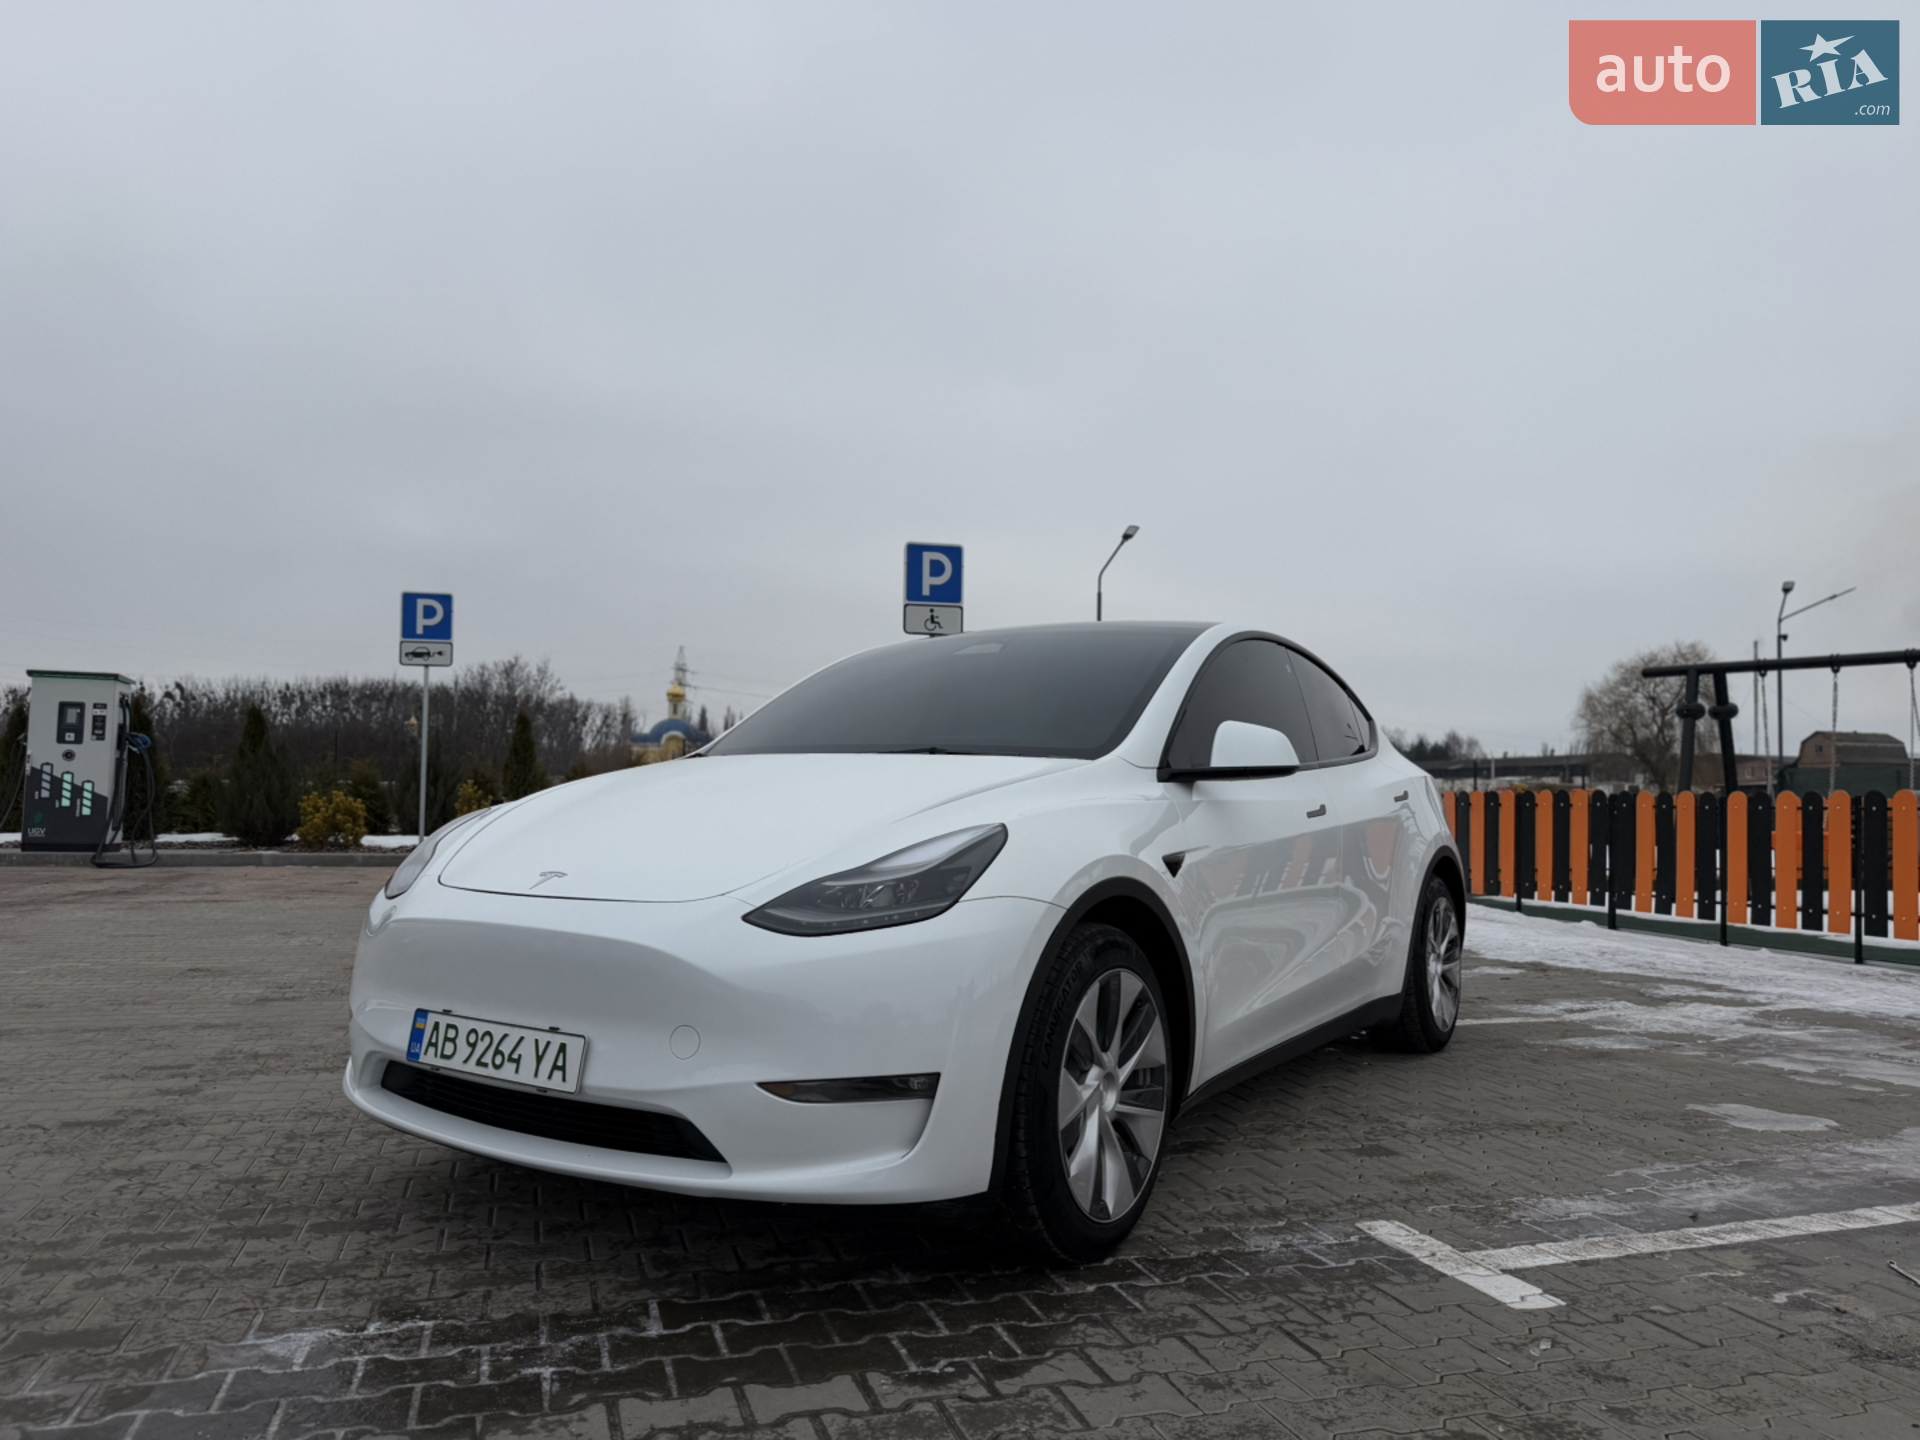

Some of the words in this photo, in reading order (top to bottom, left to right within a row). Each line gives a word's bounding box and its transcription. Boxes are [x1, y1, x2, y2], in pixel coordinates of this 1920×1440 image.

[922, 551, 953, 597] P
[416, 598, 444, 635] P
[1042, 960, 1084, 1069] LANVIGATOR
[410, 1042, 421, 1054] UA
[423, 1020, 459, 1060] AB
[462, 1027, 526, 1074] 9264
[533, 1038, 567, 1083] YA
